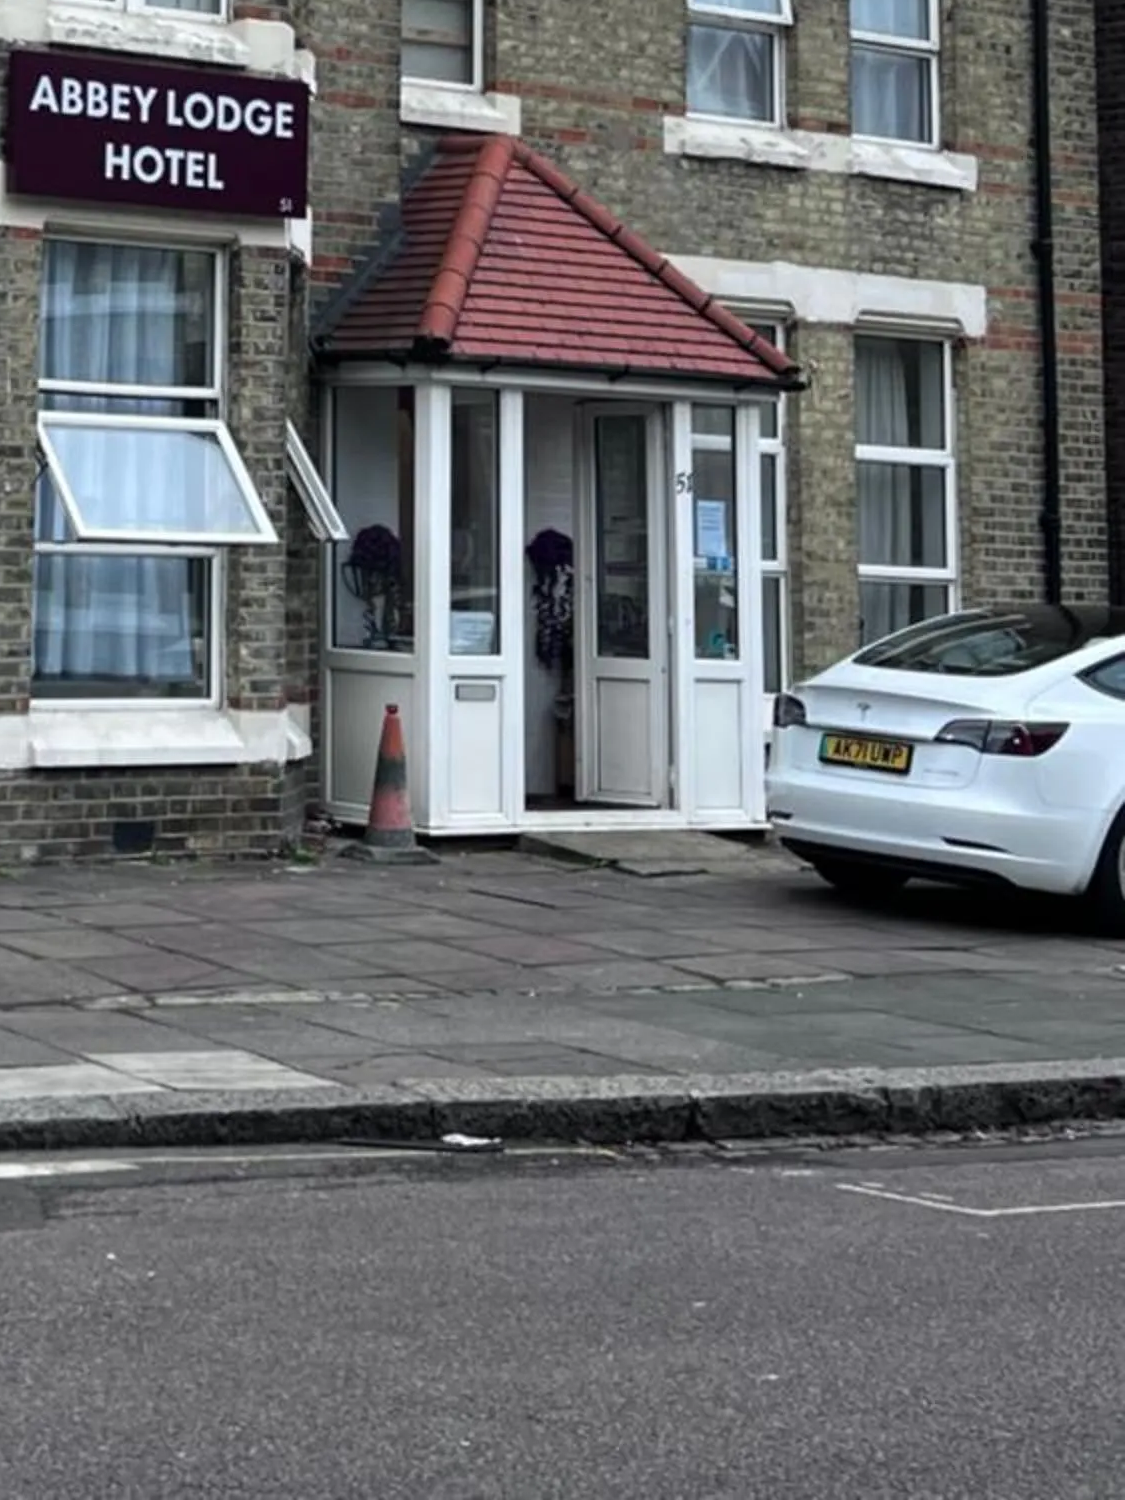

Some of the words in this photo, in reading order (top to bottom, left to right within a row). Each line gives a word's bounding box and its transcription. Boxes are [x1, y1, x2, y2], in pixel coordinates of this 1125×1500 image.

[29, 75, 158, 123] ABBEY
[166, 89, 295, 138] LODGE
[104, 142, 225, 190] HOTEL
